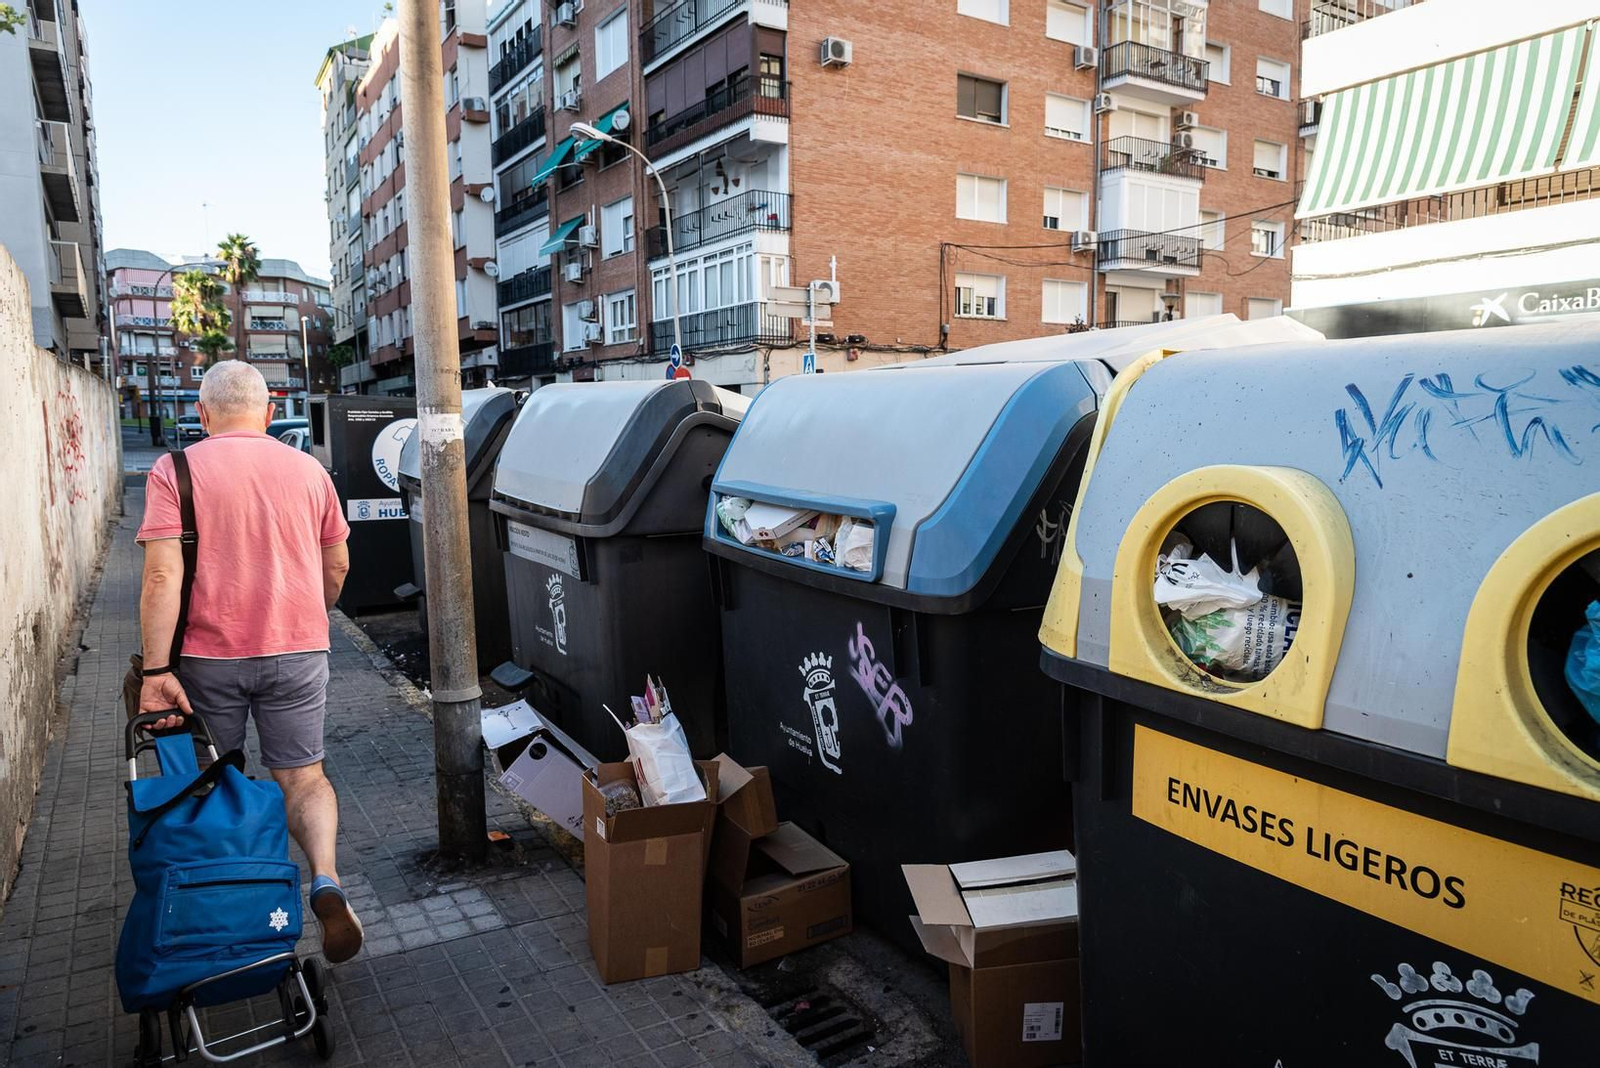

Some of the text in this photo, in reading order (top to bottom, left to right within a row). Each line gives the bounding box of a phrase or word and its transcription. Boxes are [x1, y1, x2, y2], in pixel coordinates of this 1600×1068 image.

[1518, 287, 1600, 314] CaixaB
[375, 458, 397, 486] ROPA
[1244, 614, 1255, 635] luego
[1269, 599, 1278, 630] cambio:
[1256, 614, 1266, 647] reciclado
[1267, 631, 1275, 643] usa
[1167, 776, 1467, 910] ENVASES LIGEROS
[1437, 1048, 1454, 1062] ET
